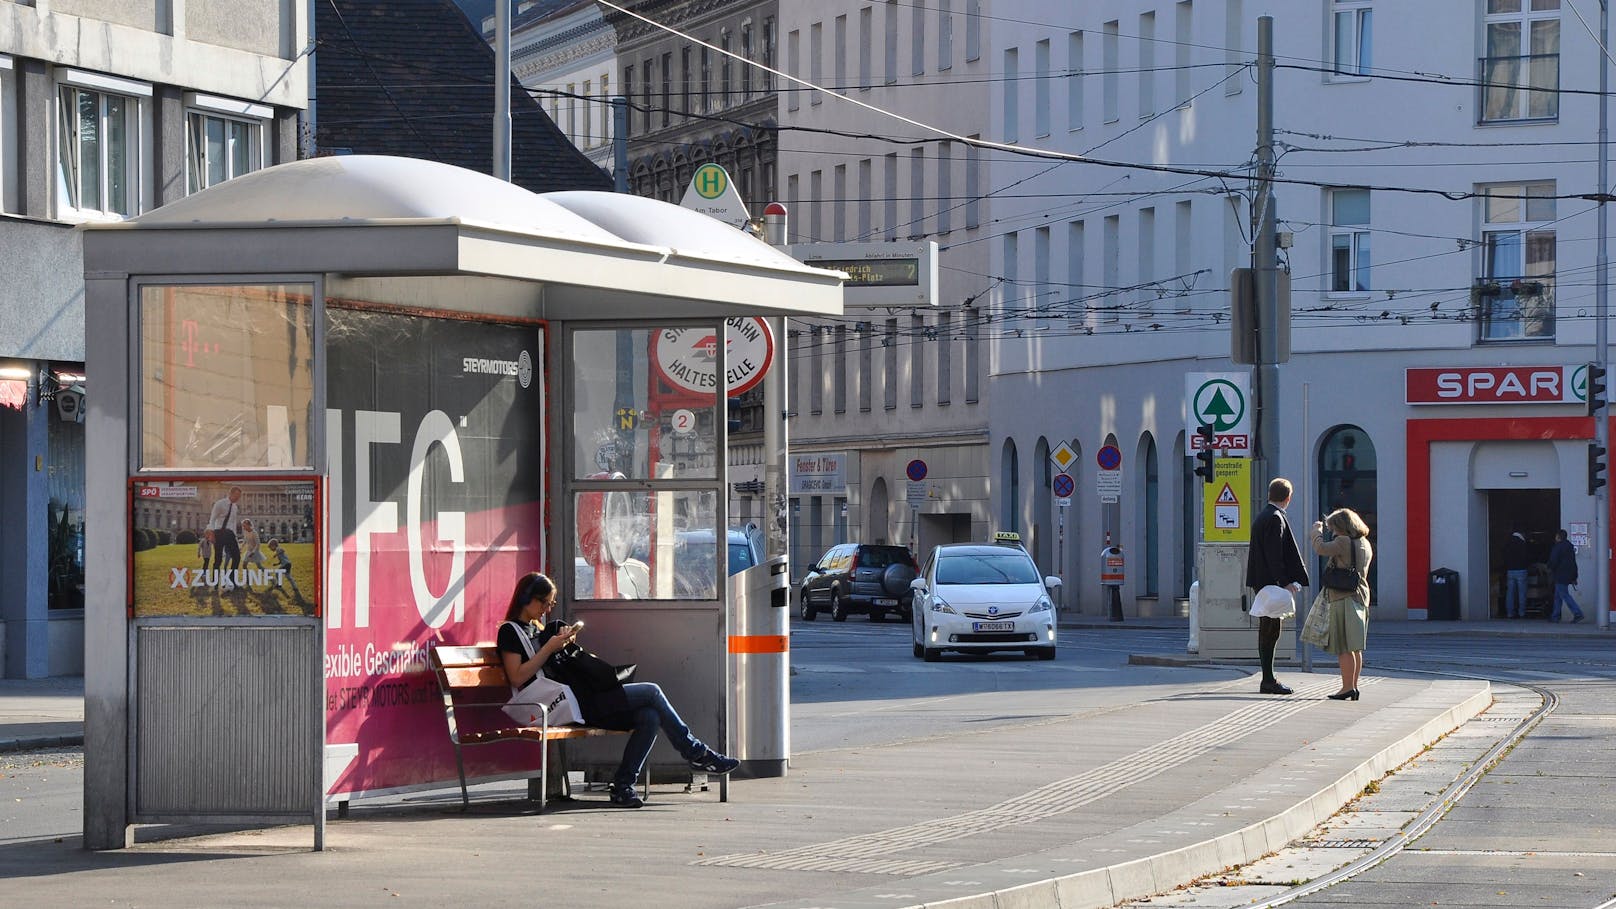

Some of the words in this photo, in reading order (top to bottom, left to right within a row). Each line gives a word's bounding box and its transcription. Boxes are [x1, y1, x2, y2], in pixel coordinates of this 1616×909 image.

[702, 171, 719, 193] H
[463, 357, 518, 376] STEYRMOTORS
[668, 358, 756, 388] HALTESELLE
[1436, 371, 1559, 398] SPAR
[621, 414, 634, 430] N
[678, 414, 688, 428] 2
[796, 458, 815, 472] Fenster
[141, 488, 157, 496] SPÖ
[191, 569, 286, 587] ZUKUNFT
[340, 686, 369, 710] STEYR
[373, 683, 409, 707] MOTORS
